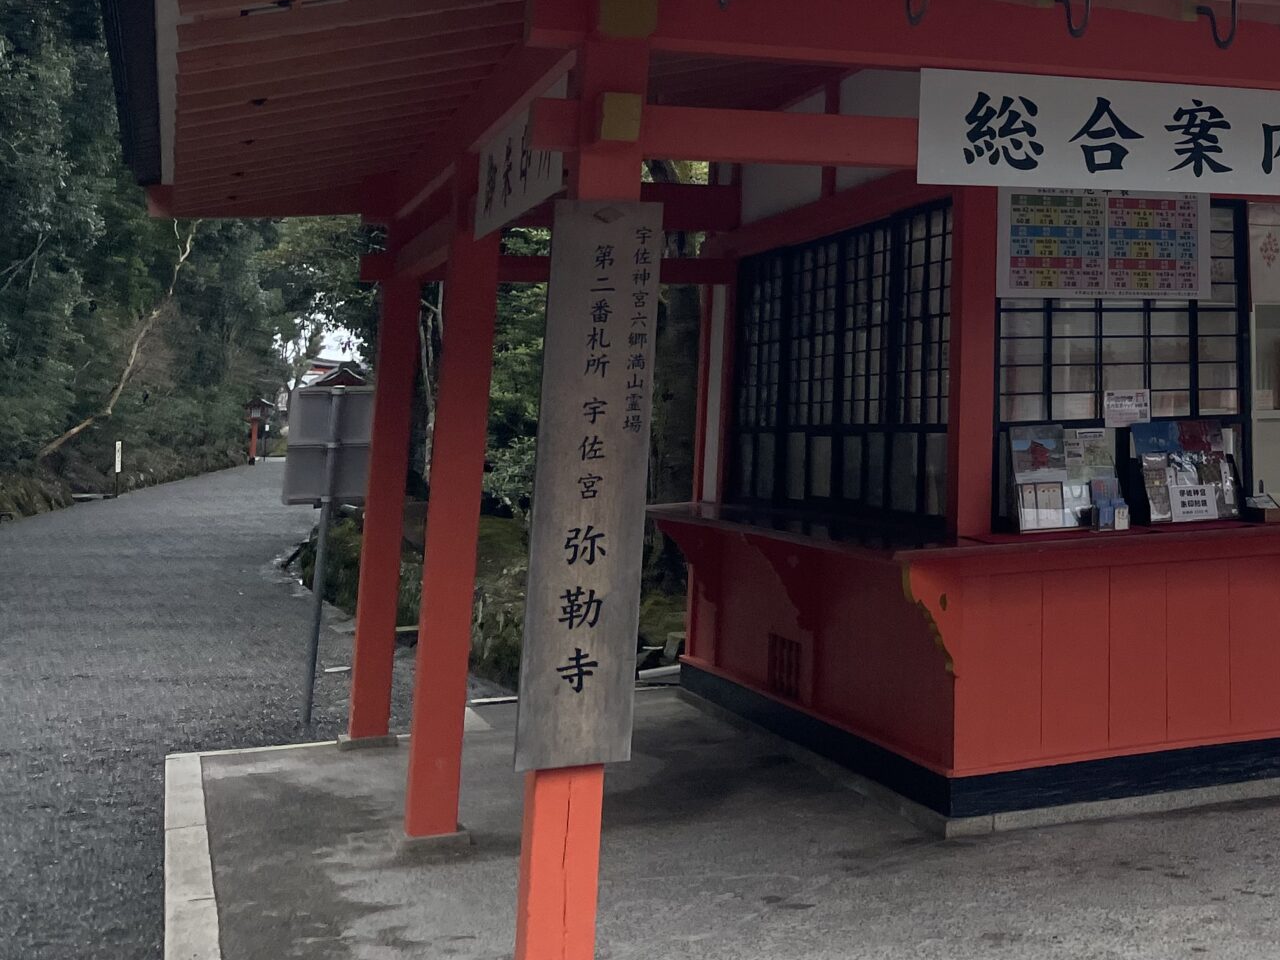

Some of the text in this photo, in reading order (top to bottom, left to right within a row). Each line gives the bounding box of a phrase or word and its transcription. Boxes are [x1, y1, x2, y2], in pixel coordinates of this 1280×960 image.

[556, 245, 615, 694] 第二番札所 宇佐宮 弥勒寺
[622, 226, 652, 433] 宇佐神宮六郷満山霊場
